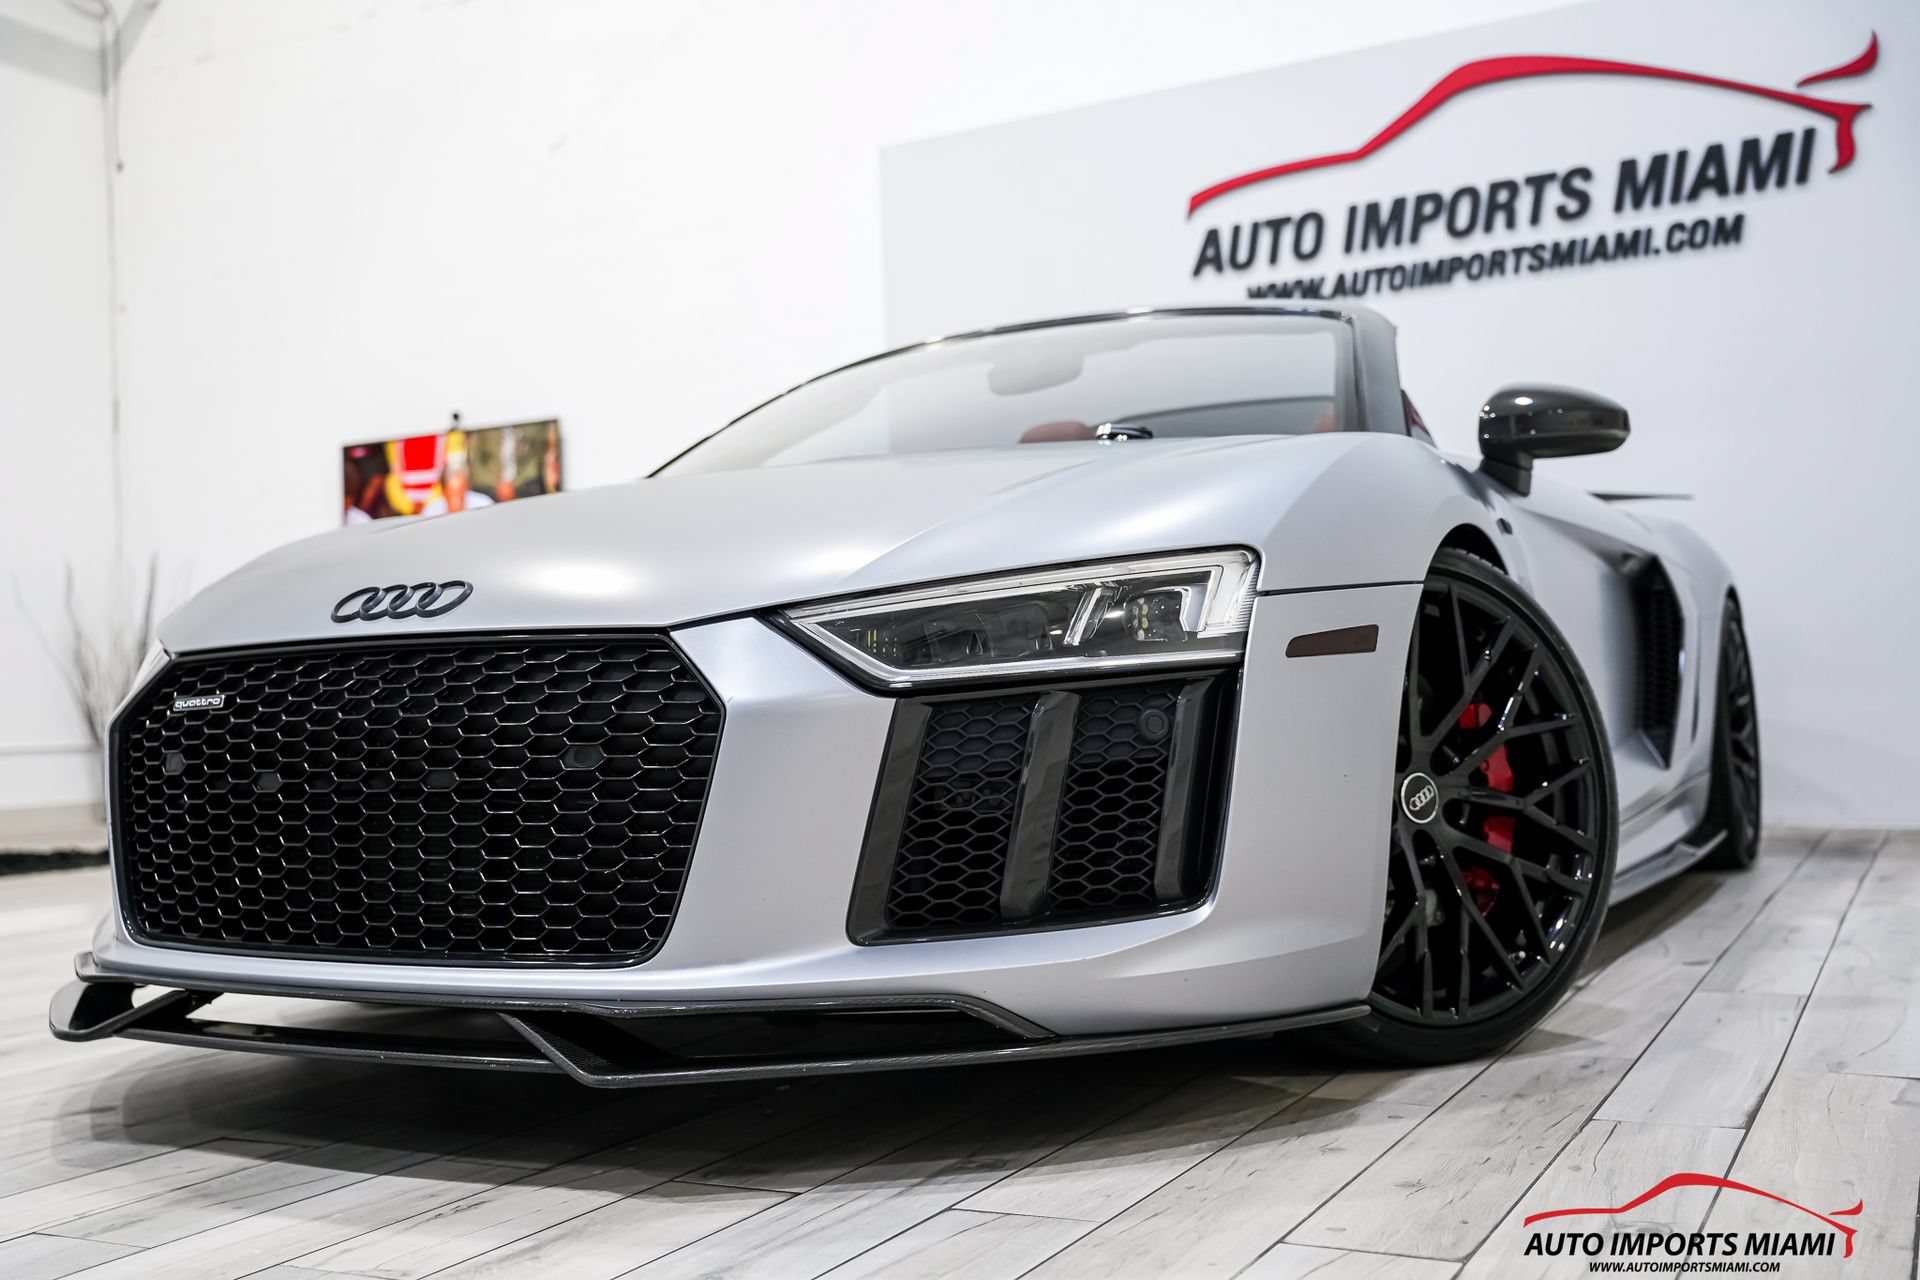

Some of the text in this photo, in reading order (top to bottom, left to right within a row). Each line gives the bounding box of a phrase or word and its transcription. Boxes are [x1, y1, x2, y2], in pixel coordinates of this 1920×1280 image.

[1193, 127, 1816, 277] AUTO IMPORTS MIAMI
[175, 698, 221, 709] quattro
